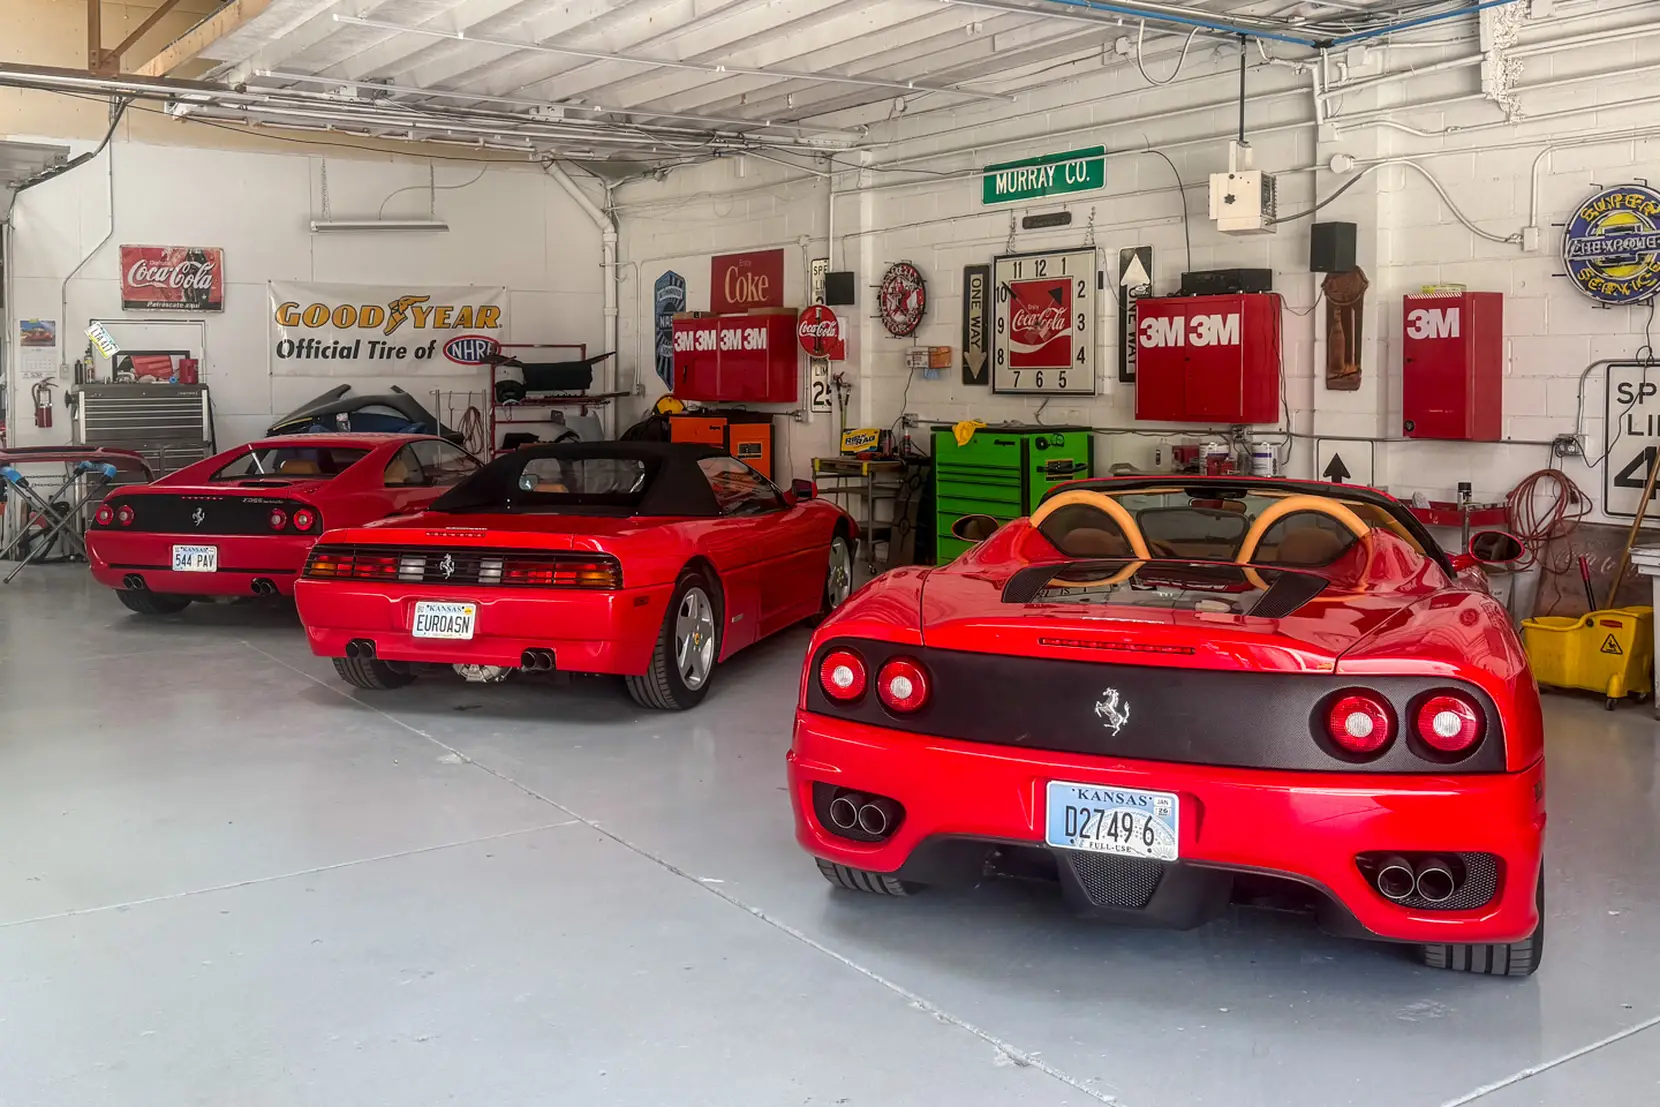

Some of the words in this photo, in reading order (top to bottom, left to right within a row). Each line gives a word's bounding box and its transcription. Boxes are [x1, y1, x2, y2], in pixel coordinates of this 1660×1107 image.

[996, 166, 1056, 194] MURRAY
[1065, 160, 1090, 184] CO.
[127, 259, 217, 289] Coca-Cola
[1013, 261, 1022, 279] 11
[1034, 259, 1046, 278] 12
[1062, 257, 1066, 275] 1
[724, 265, 769, 303] Coke
[971, 278, 982, 310] ONE
[996, 285, 1007, 303] 10
[1078, 280, 1086, 298] 2
[799, 320, 837, 338] Coca-Cola
[997, 317, 1004, 334] 9
[1012, 307, 1068, 332] Coca-Cola
[1077, 313, 1086, 332] 3
[1407, 307, 1460, 340] 3M
[674, 331, 694, 352] 3M
[695, 330, 717, 351] 3M
[720, 328, 742, 351] 3M
[744, 328, 768, 350] 3M
[970, 316, 982, 349] WAY
[1139, 316, 1185, 348] 3M
[1188, 314, 1240, 347] 3M
[276, 339, 361, 359] Official
[368, 341, 407, 360] Tire
[414, 340, 437, 360] of
[997, 348, 1004, 366] 8
[1076, 346, 1086, 364] 4
[1013, 370, 1021, 388] 7
[1036, 370, 1044, 388] 6
[1058, 370, 1067, 388] 5
[1617, 382, 1658, 405] SP
[176, 554, 192, 567] 544
[416, 614, 470, 634] EUROASN
[1078, 789, 1148, 806] KANSAS
[1089, 842, 1132, 853] FULL-USE
